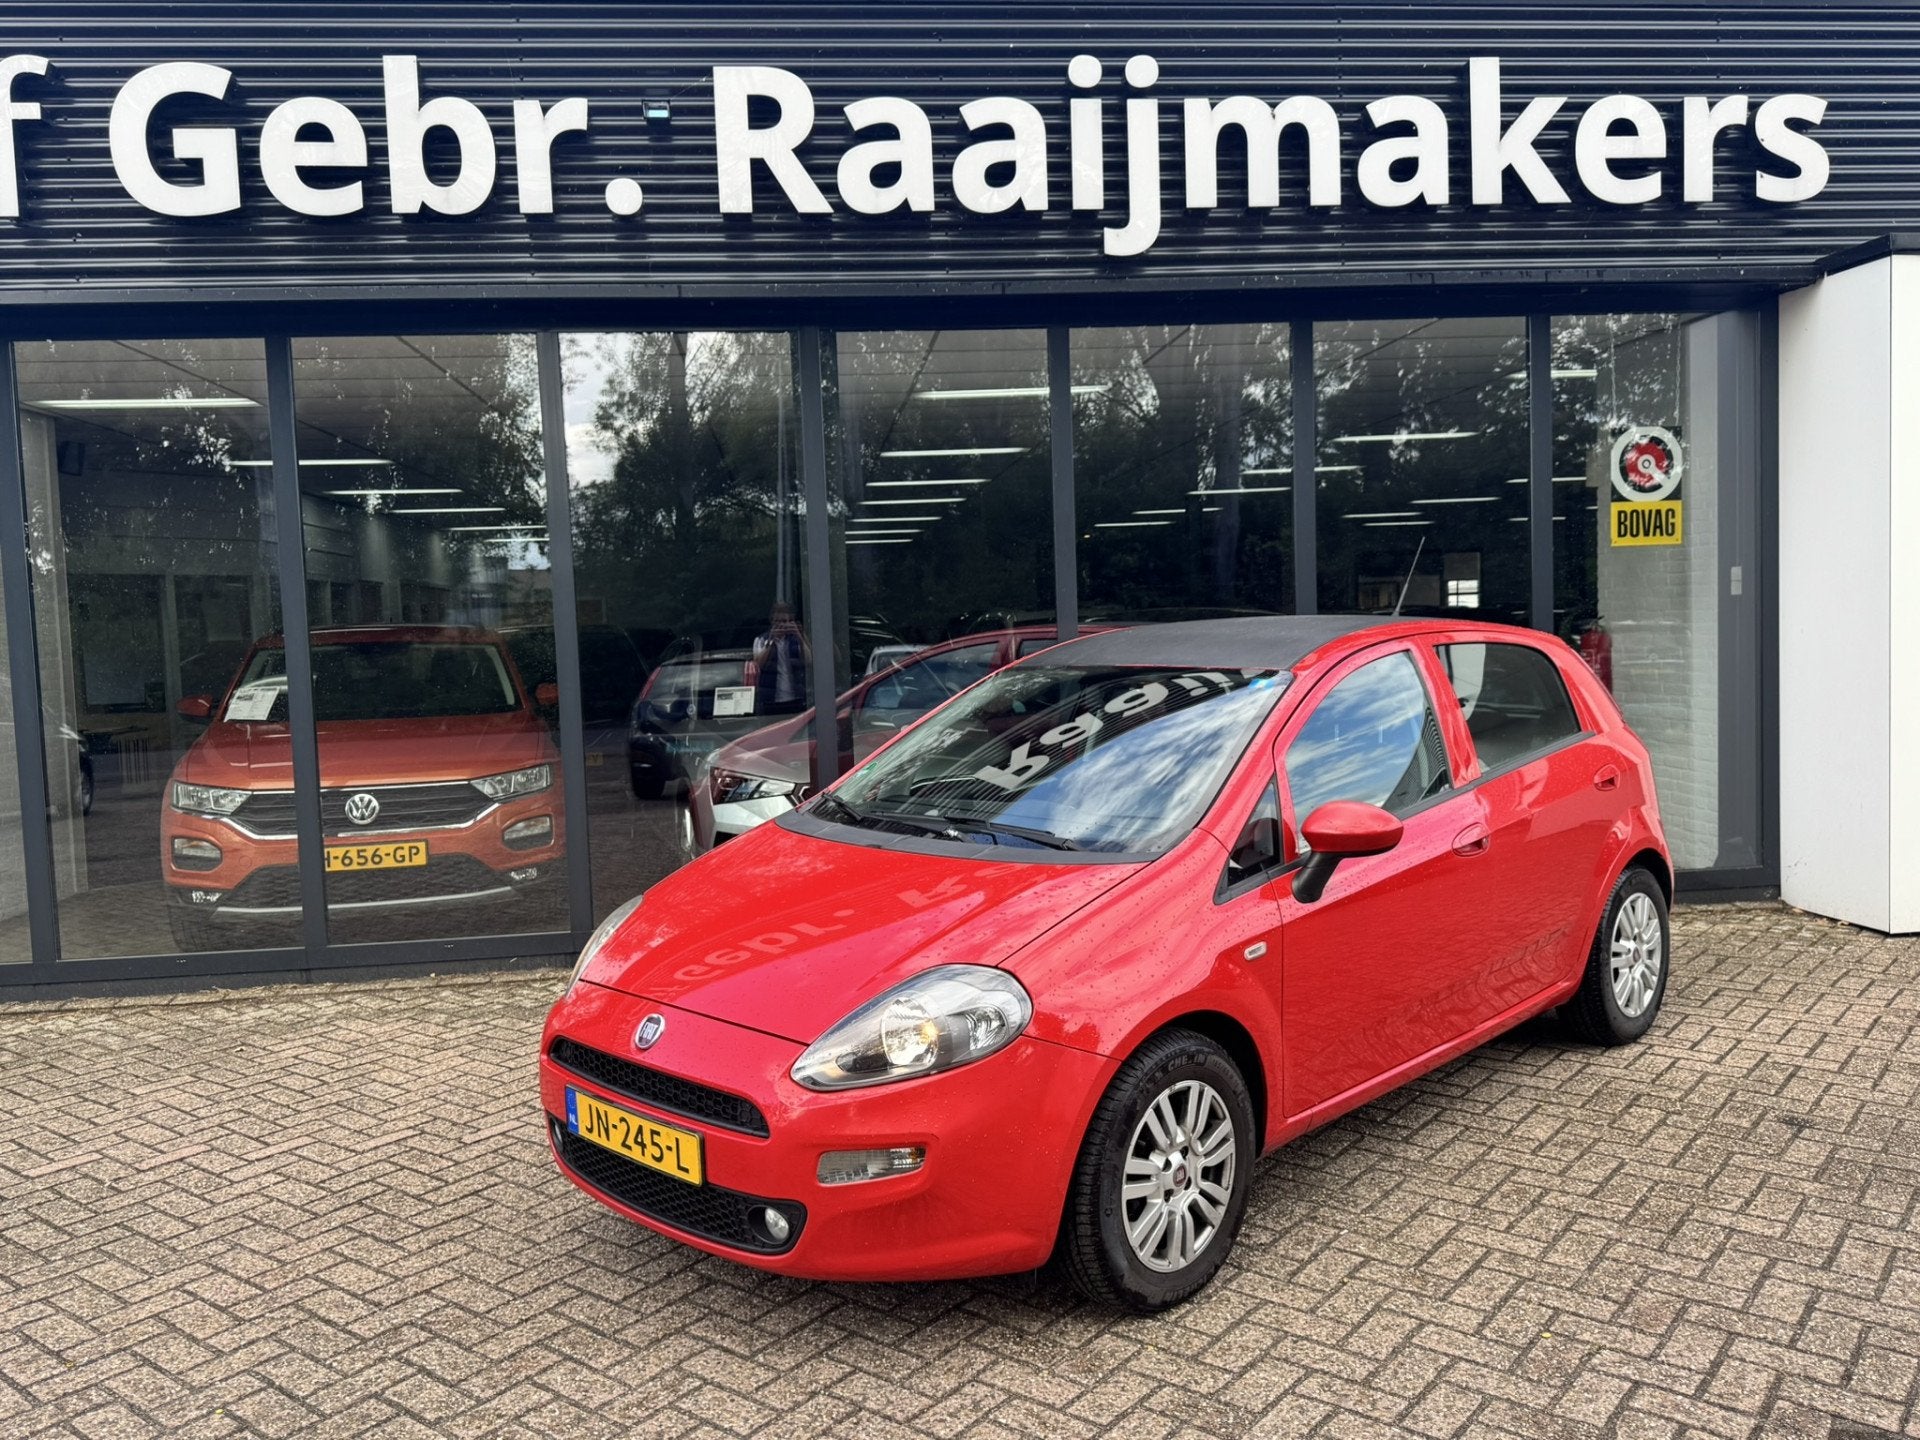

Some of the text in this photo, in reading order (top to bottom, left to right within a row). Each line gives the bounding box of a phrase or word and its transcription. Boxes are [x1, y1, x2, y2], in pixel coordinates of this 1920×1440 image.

[109, 54, 643, 217] Gebr.
[712, 54, 1830, 257] Raaijmakers
[1617, 508, 1676, 538] BOVAG
[585, 1103, 690, 1174] JN-245-L
